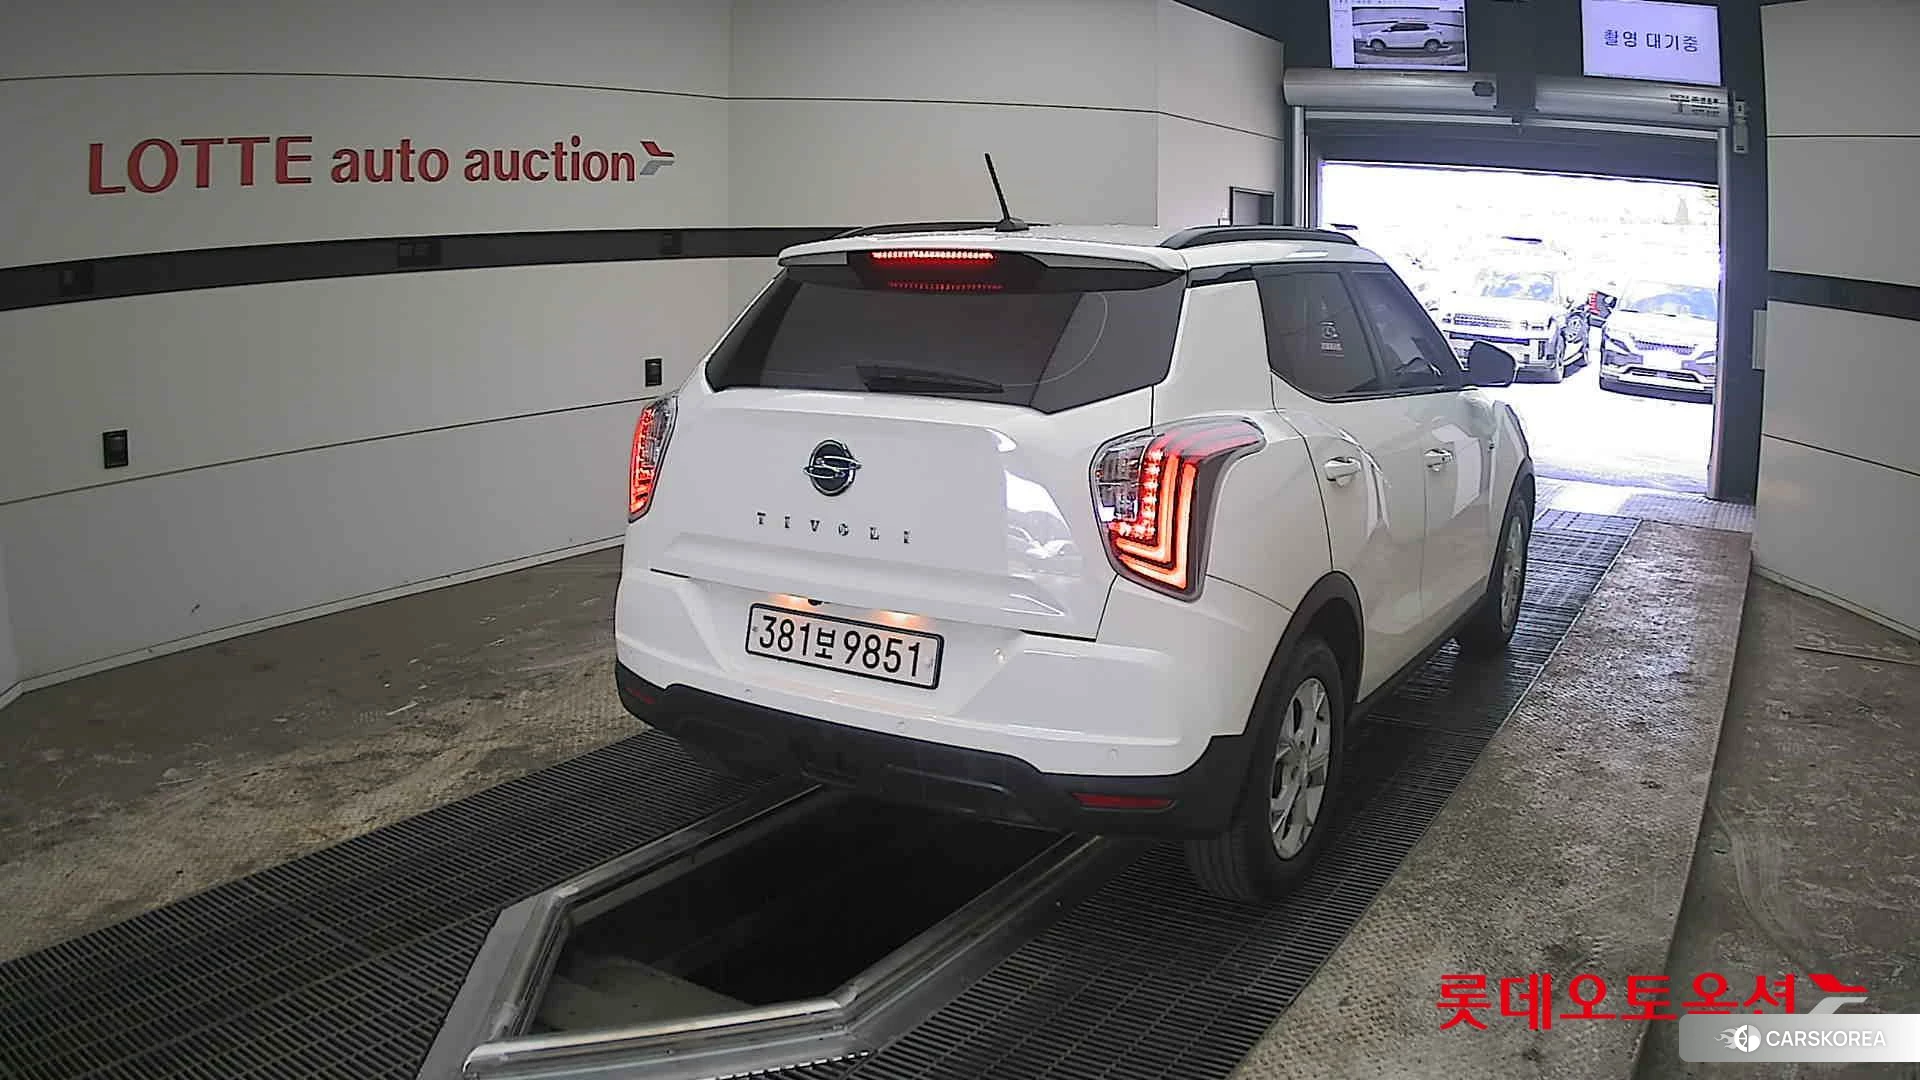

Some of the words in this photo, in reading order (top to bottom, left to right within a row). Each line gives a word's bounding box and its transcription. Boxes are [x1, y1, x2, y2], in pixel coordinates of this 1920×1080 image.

[1646, 33, 1698, 52] 대기중
[88, 136, 313, 195] LOTTE
[330, 139, 450, 184] auto
[463, 134, 636, 183] auction
[756, 511, 913, 544] TIVOLI
